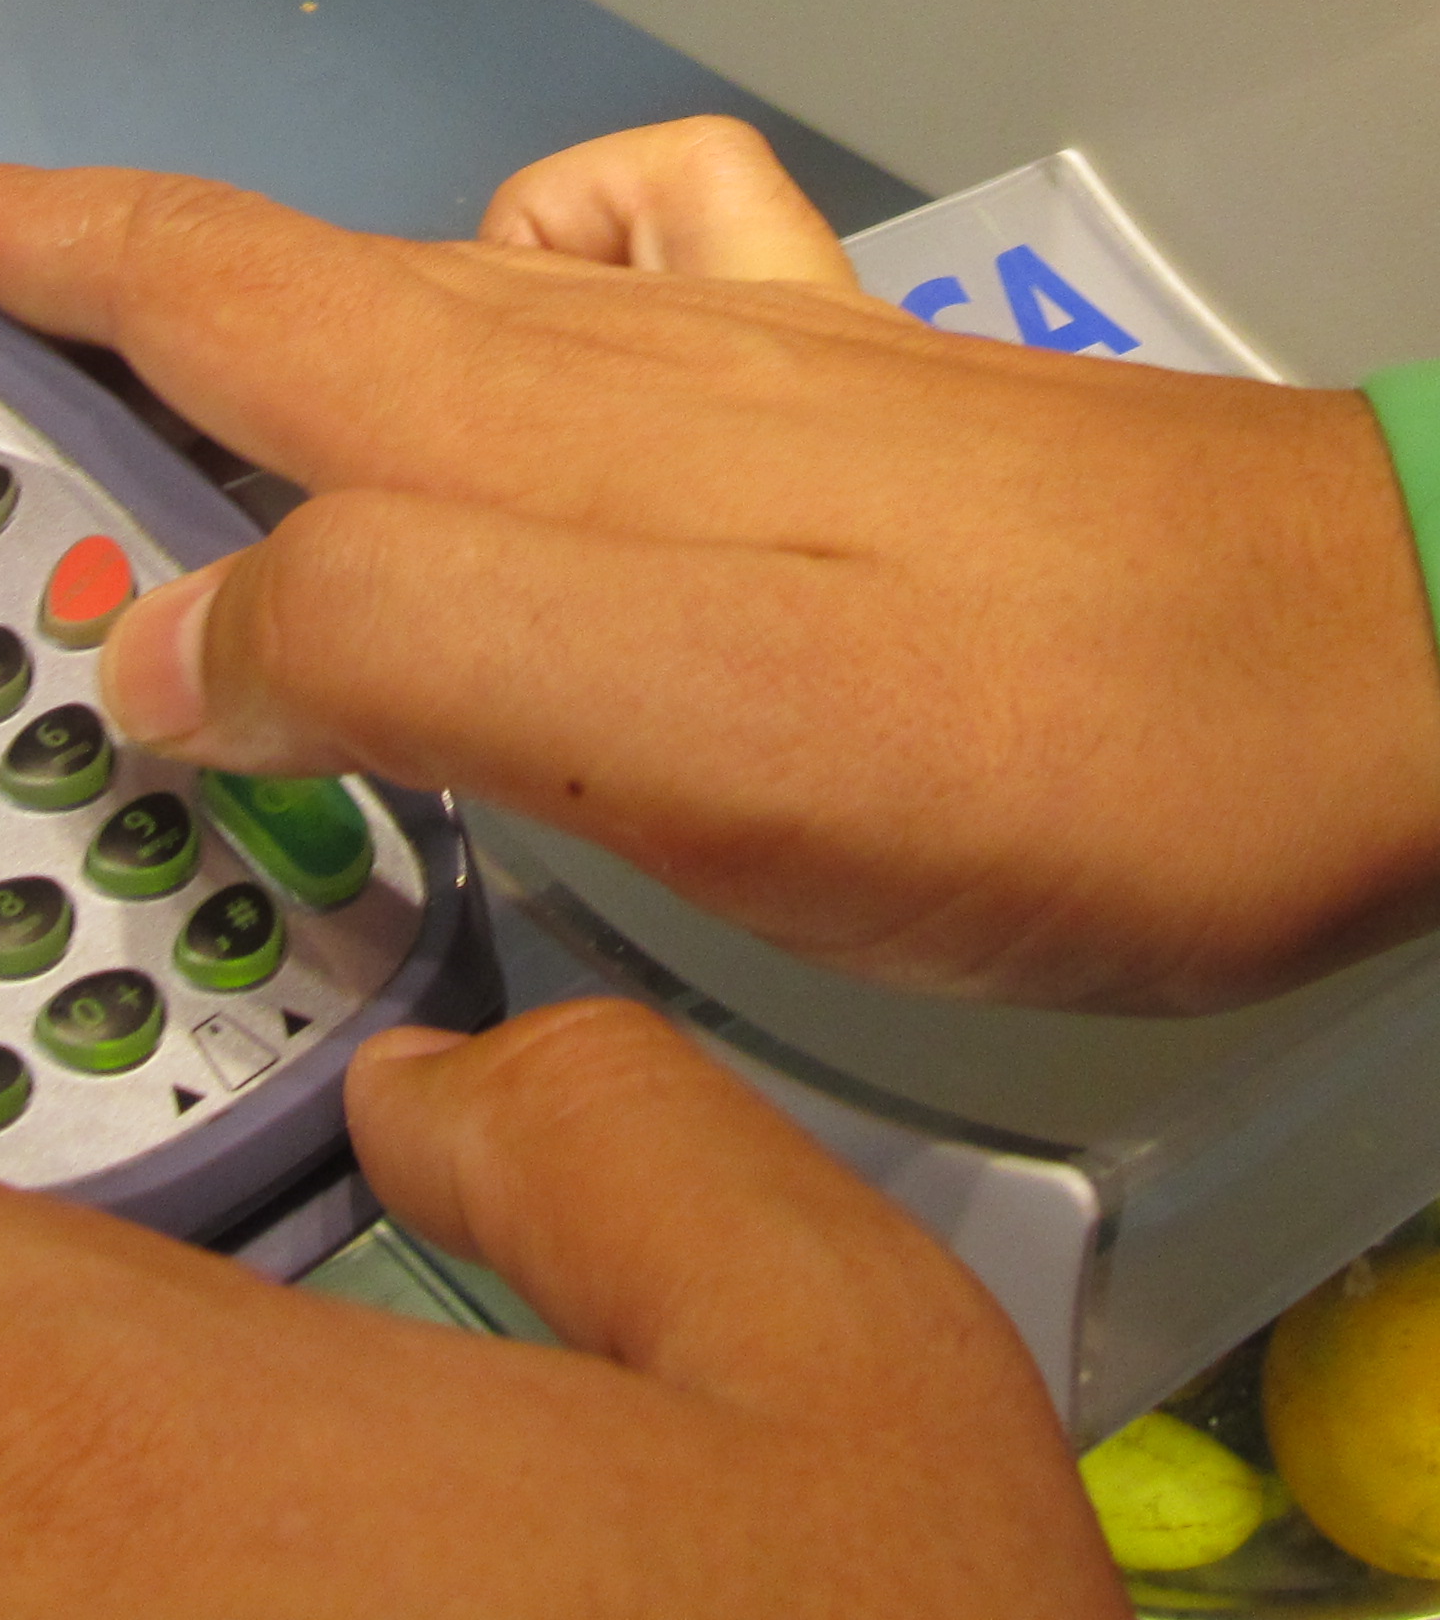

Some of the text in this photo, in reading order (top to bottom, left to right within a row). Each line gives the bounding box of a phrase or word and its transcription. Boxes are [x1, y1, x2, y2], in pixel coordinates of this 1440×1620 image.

[37, 721, 70, 748] 6
[123, 808, 156, 838] 9
[71, 995, 106, 1028] 0
